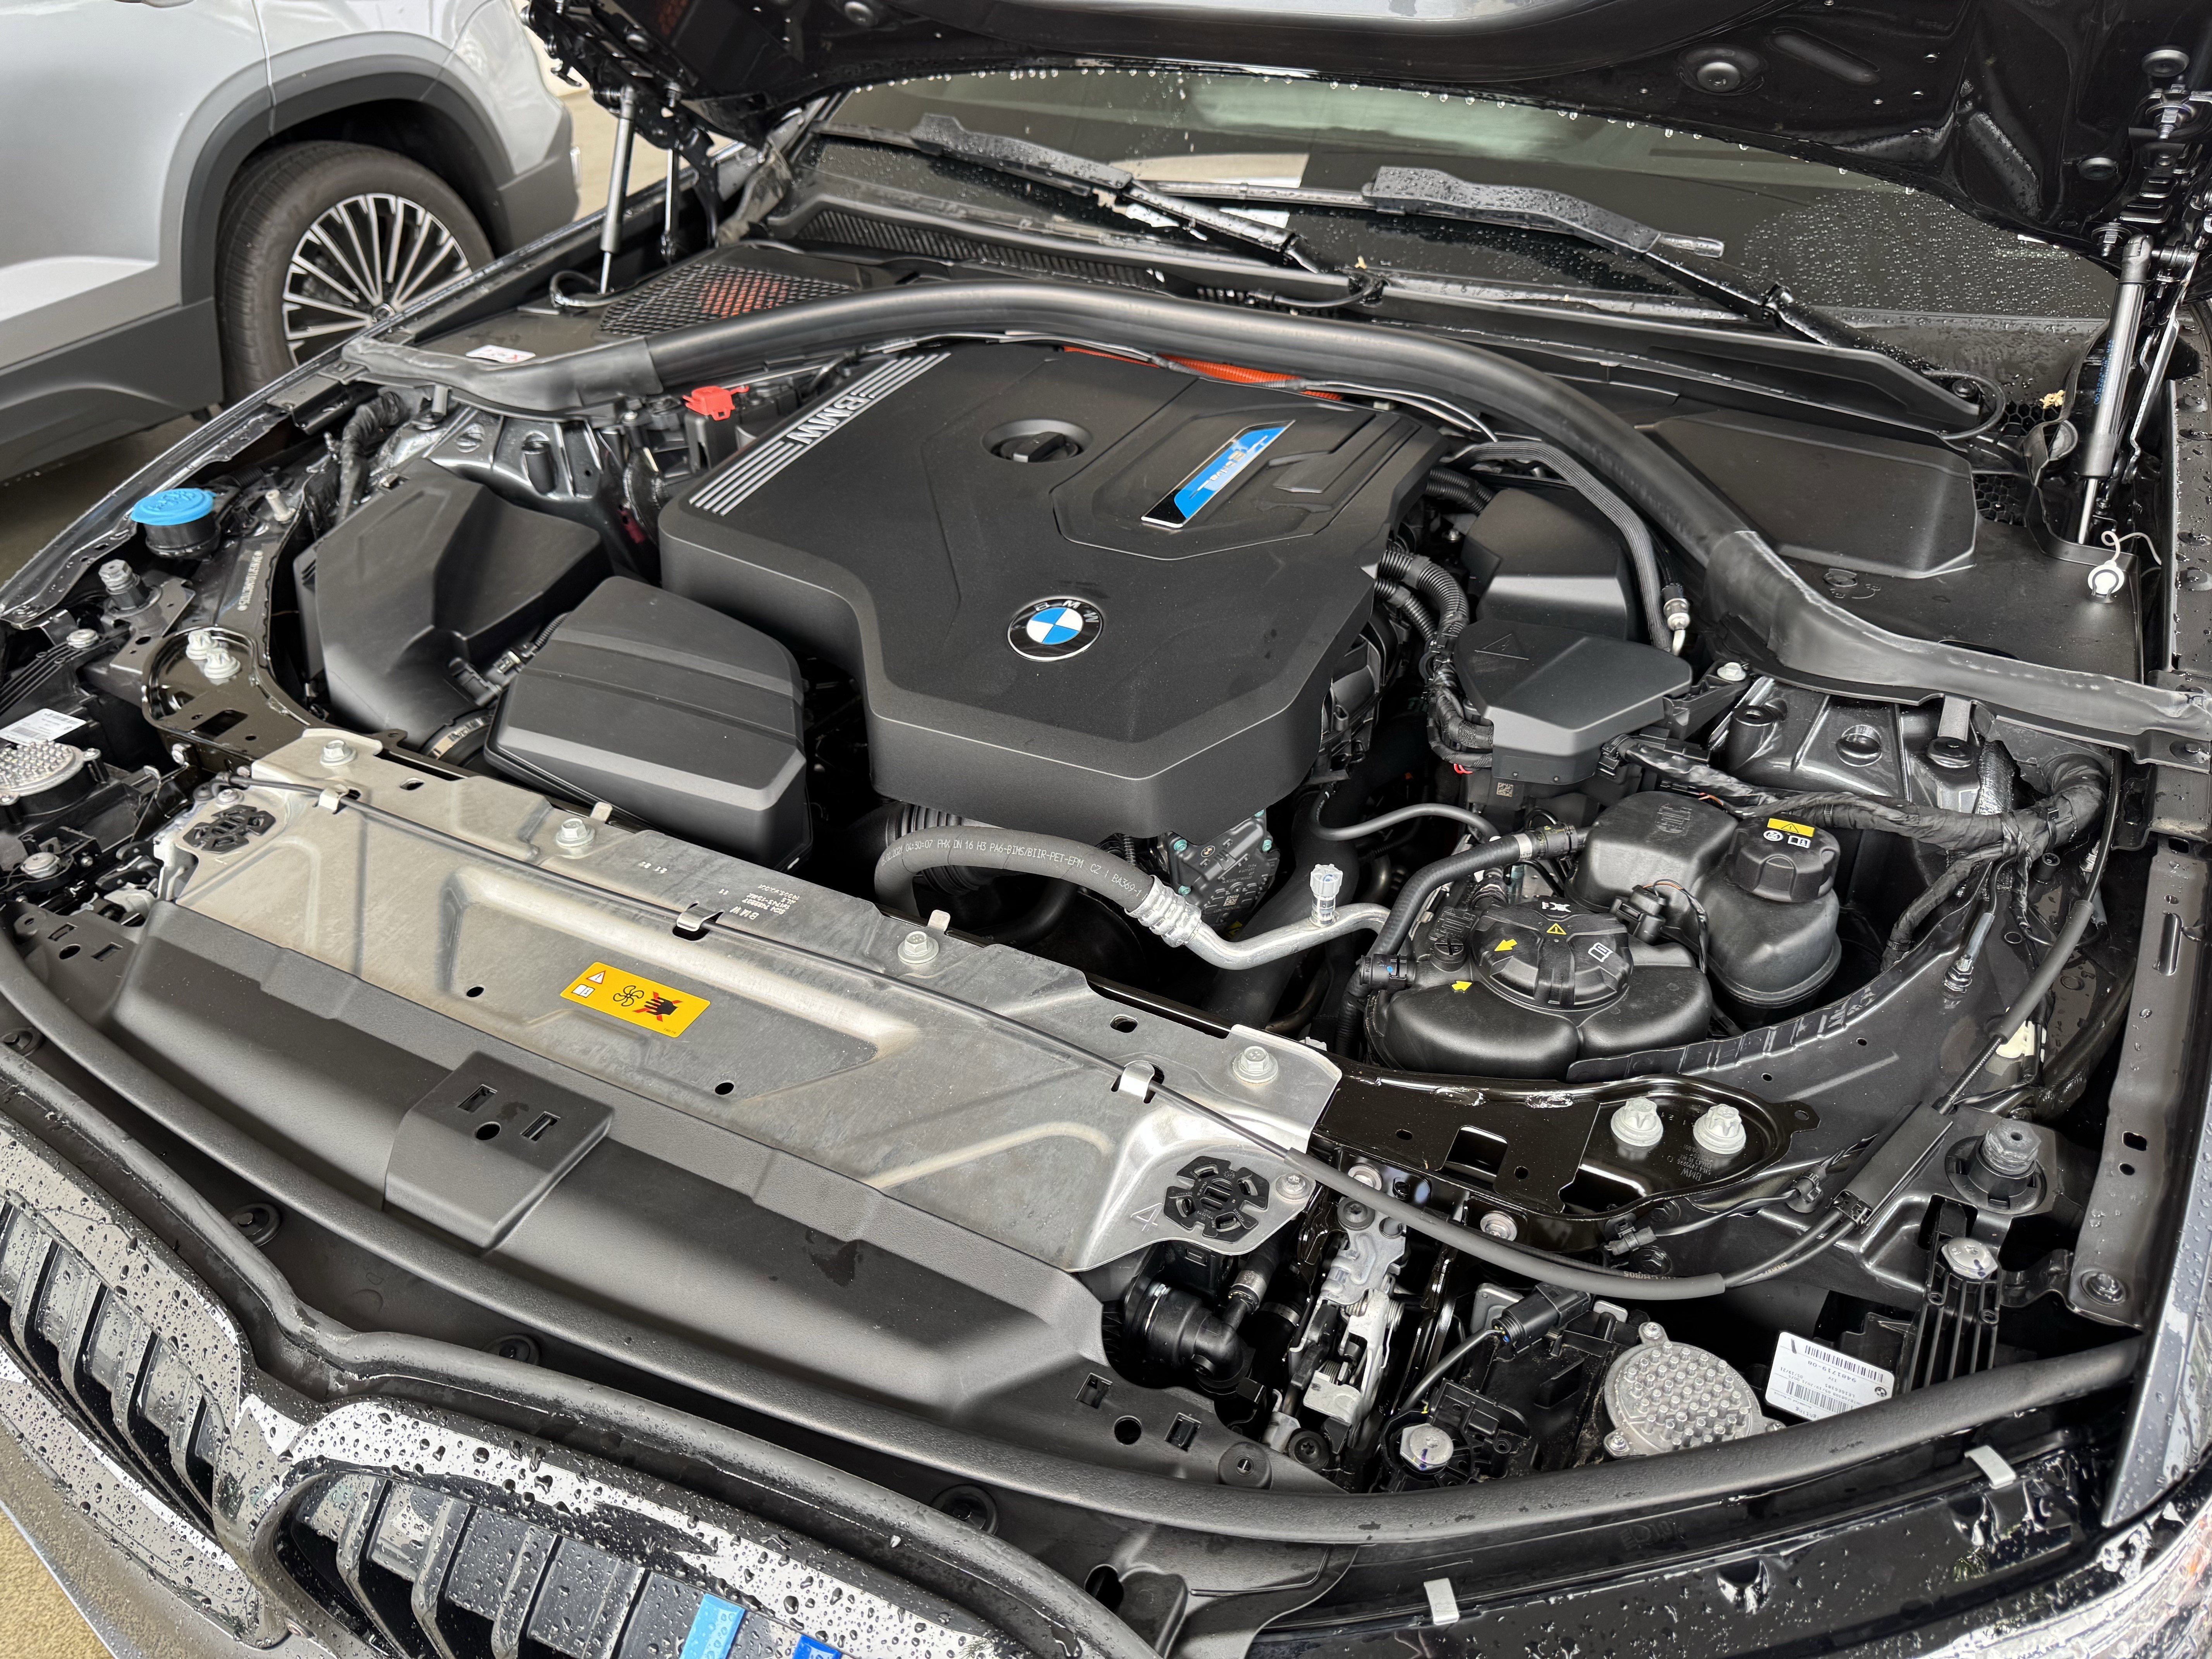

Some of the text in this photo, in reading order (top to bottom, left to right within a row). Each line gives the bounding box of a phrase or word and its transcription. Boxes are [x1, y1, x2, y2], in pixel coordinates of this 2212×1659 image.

[786, 395, 871, 444] BMW
[1034, 600, 1099, 623] BMW
[905, 839, 934, 852] 04:30:07
[937, 839, 951, 848] PHX
[953, 839, 963, 849] DN
[965, 841, 974, 850] 16
[976, 840, 987, 851] H3
[1090, 864, 1102, 874] CZ
[1111, 873, 1142, 897] BA369-1
[729, 906, 760, 920] BMW
[1680, 1167, 1702, 1181] BMW
[1808, 1360, 1856, 1383] 9481719-08
[1795, 1406, 1819, 1420] ighting
